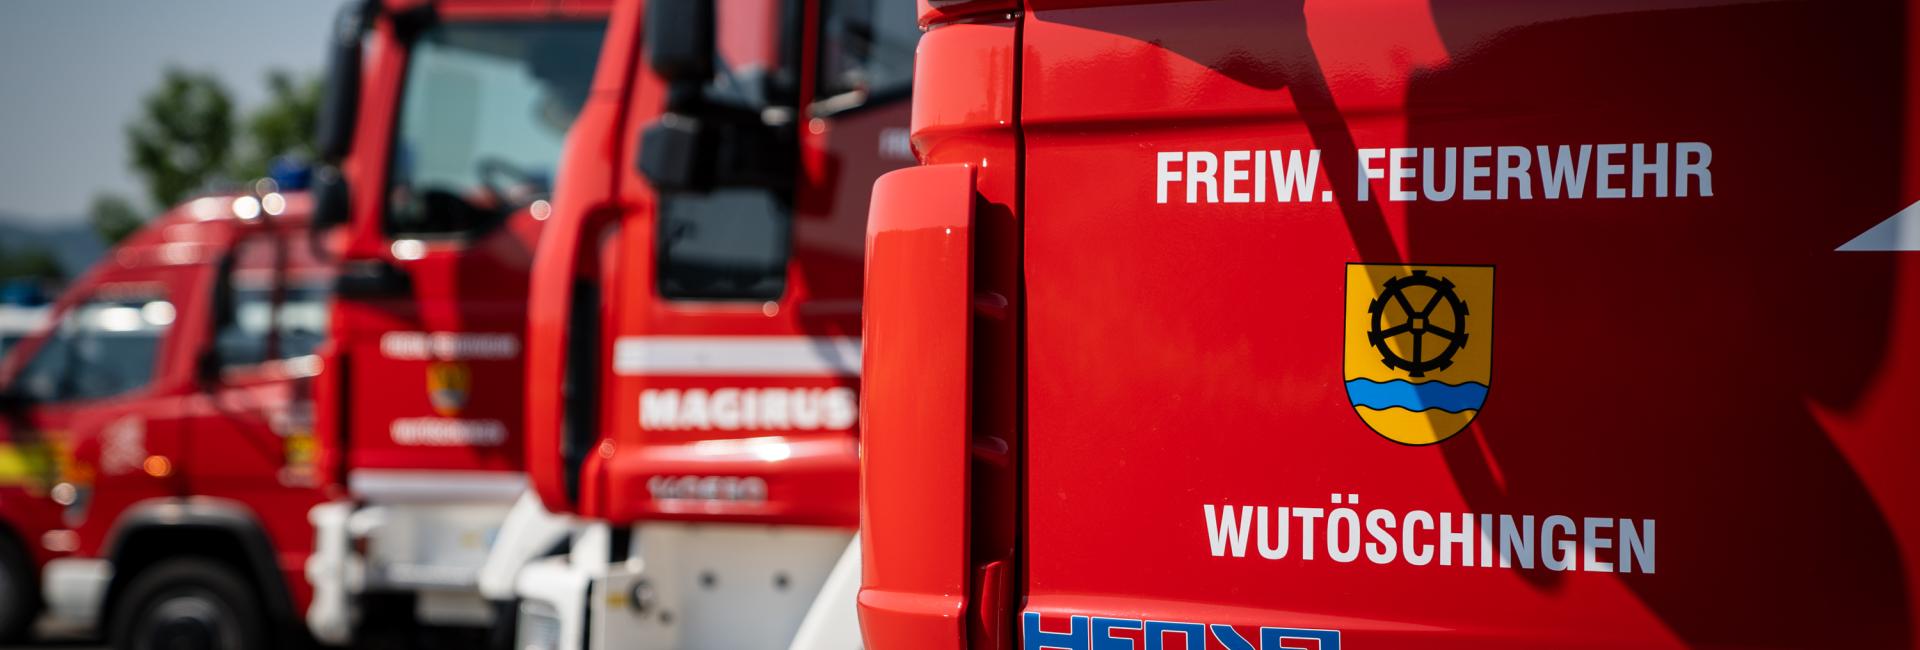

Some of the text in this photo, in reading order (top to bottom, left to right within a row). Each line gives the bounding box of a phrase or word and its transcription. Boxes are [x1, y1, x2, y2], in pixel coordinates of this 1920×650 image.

[1157, 142, 1713, 203] FREIW. FEUERWEHR
[640, 388, 858, 431] MAGIRUS
[1204, 493, 1655, 574] WUTÖSCHINGEN
